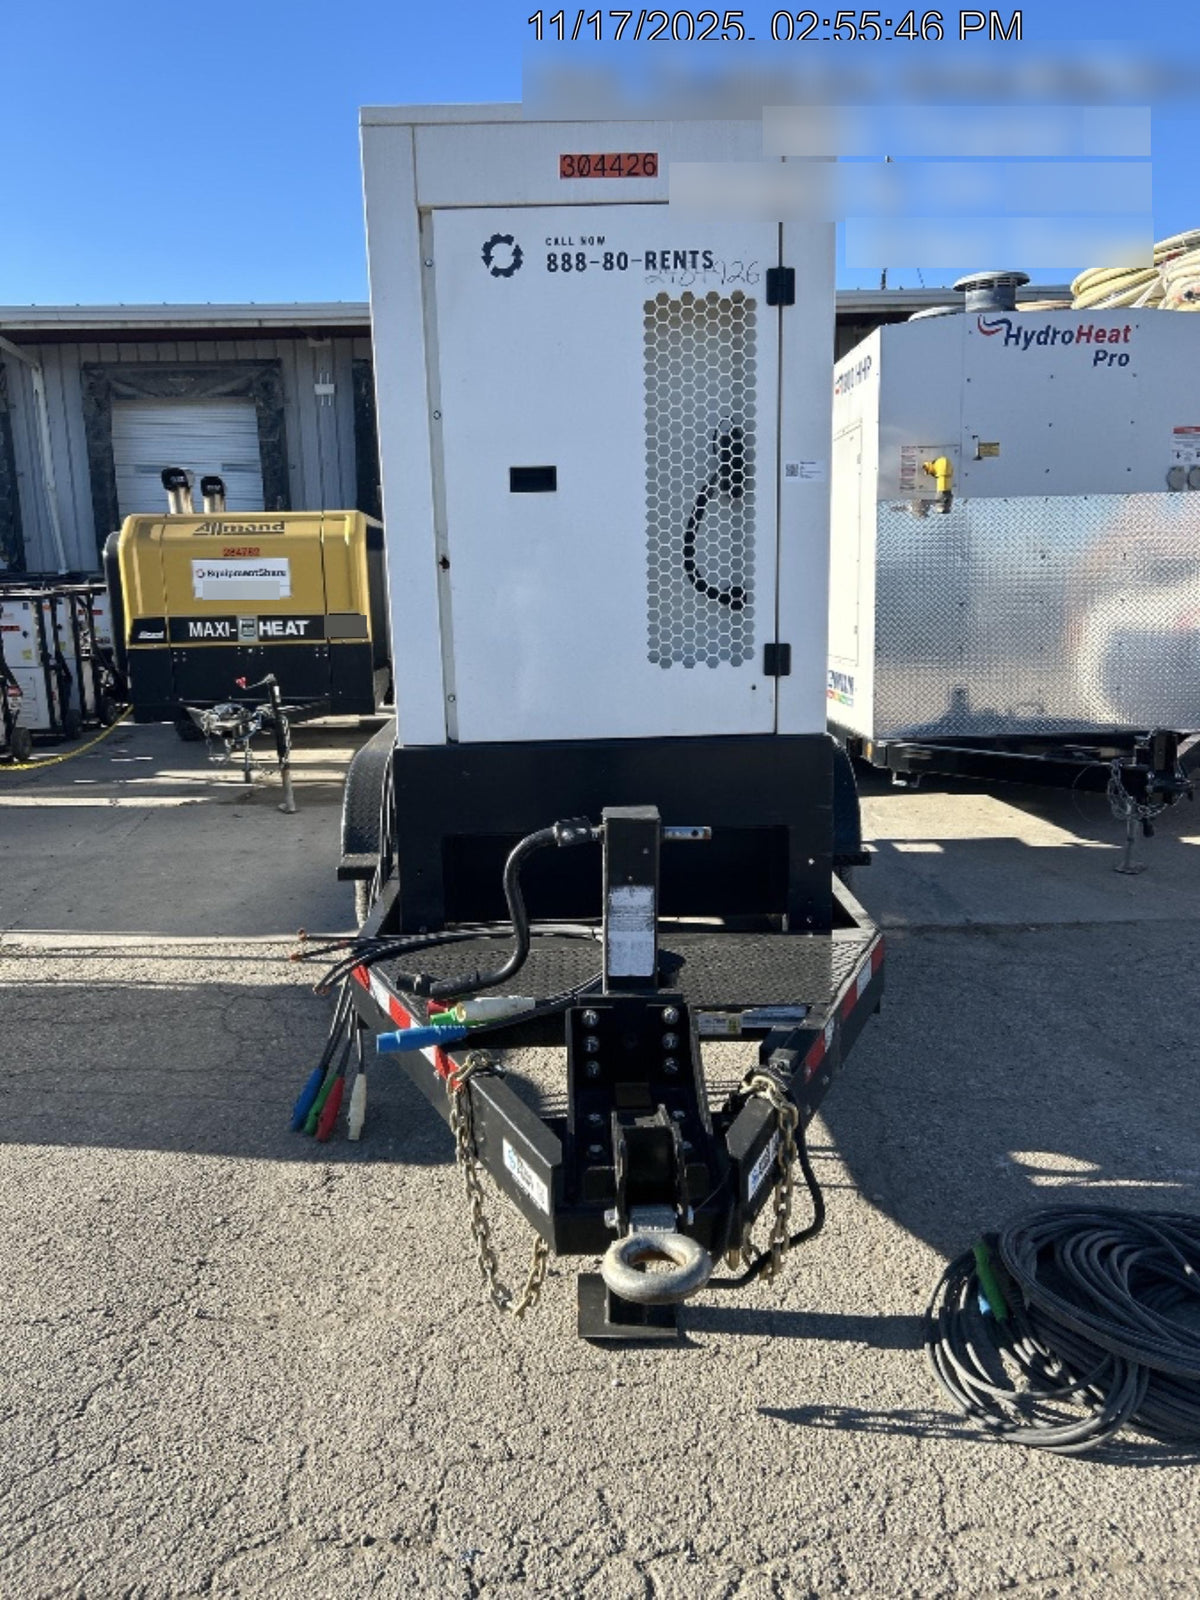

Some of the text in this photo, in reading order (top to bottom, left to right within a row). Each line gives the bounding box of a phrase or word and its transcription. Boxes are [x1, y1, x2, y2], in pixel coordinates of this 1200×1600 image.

[562, 153, 657, 178] 304426
[545, 236, 605, 246] CALL NOW
[546, 250, 714, 272] 888-80-RENTS
[1002, 322, 1132, 351] HydroHeat
[1092, 350, 1130, 367] Pro
[192, 520, 285, 535] Allmand
[258, 620, 310, 637] HEAT
